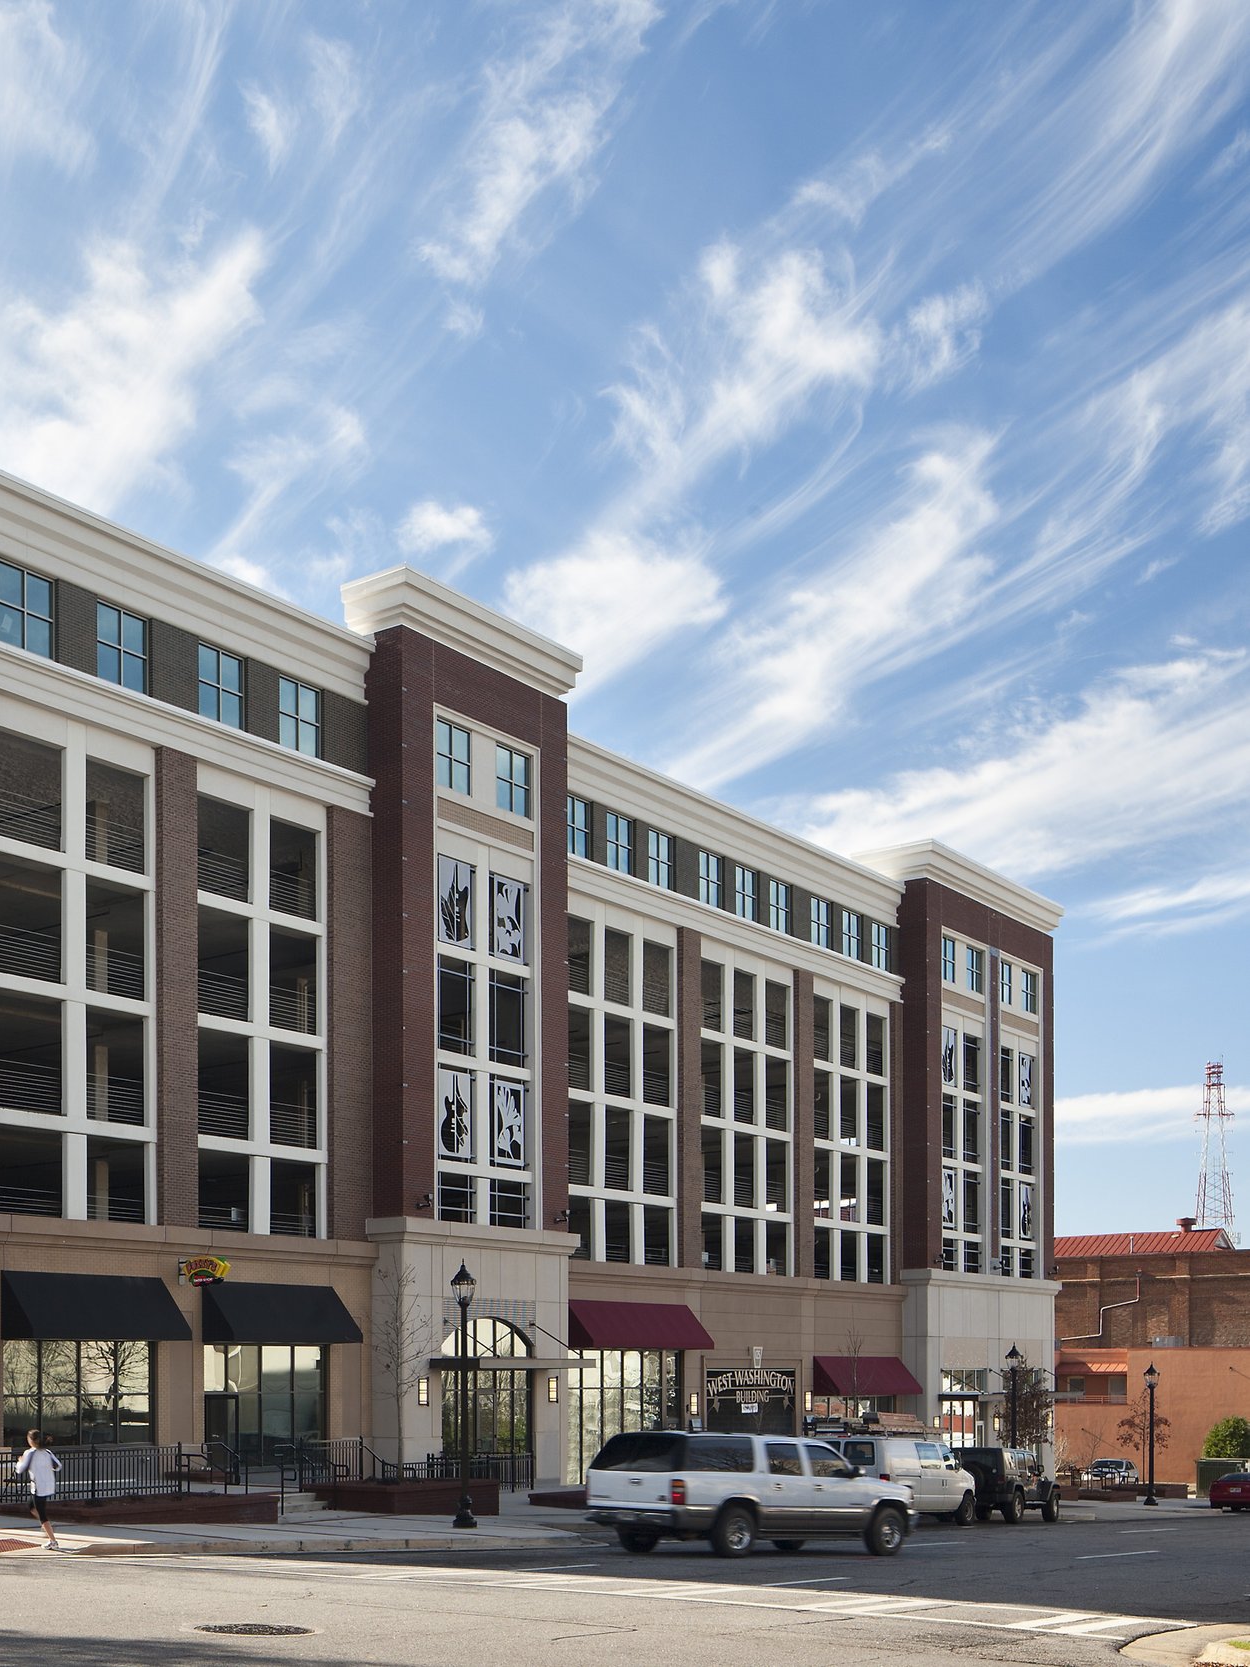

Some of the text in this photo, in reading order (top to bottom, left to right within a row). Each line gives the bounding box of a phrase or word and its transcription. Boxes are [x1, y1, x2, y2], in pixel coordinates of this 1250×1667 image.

[707, 1369, 795, 1396] WEST WASHINGTON
[736, 1390, 769, 1403] BUILDING
